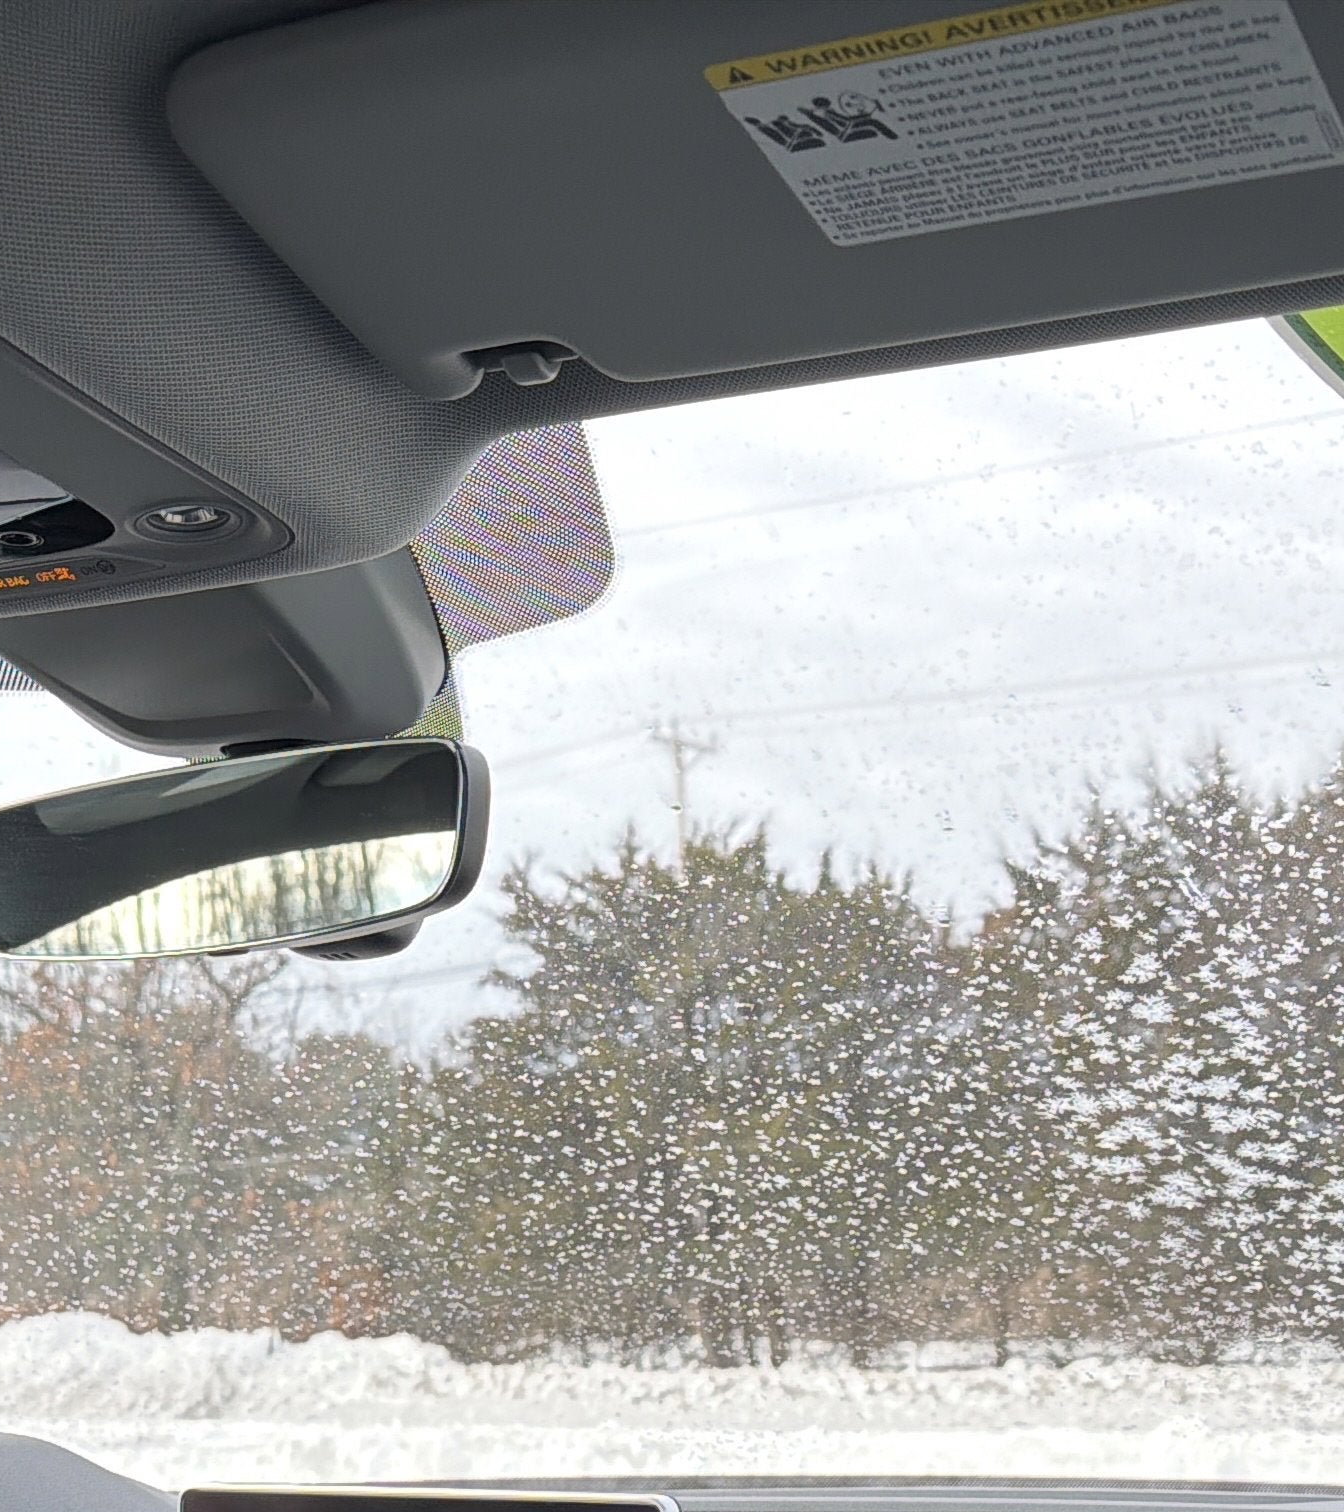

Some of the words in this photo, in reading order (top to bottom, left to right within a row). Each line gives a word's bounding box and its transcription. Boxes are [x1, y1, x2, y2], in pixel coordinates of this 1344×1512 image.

[764, 30, 933, 74] WARNING!
[875, 59, 932, 79] EVEN
[934, 48, 993, 68] WITH
[993, 24, 1116, 57] ADVANCED
[1118, 16, 1159, 33] AIR
[1161, 4, 1224, 25] BAGS
[7, 575, 30, 588] BAG
[36, 570, 55, 582] OFF
